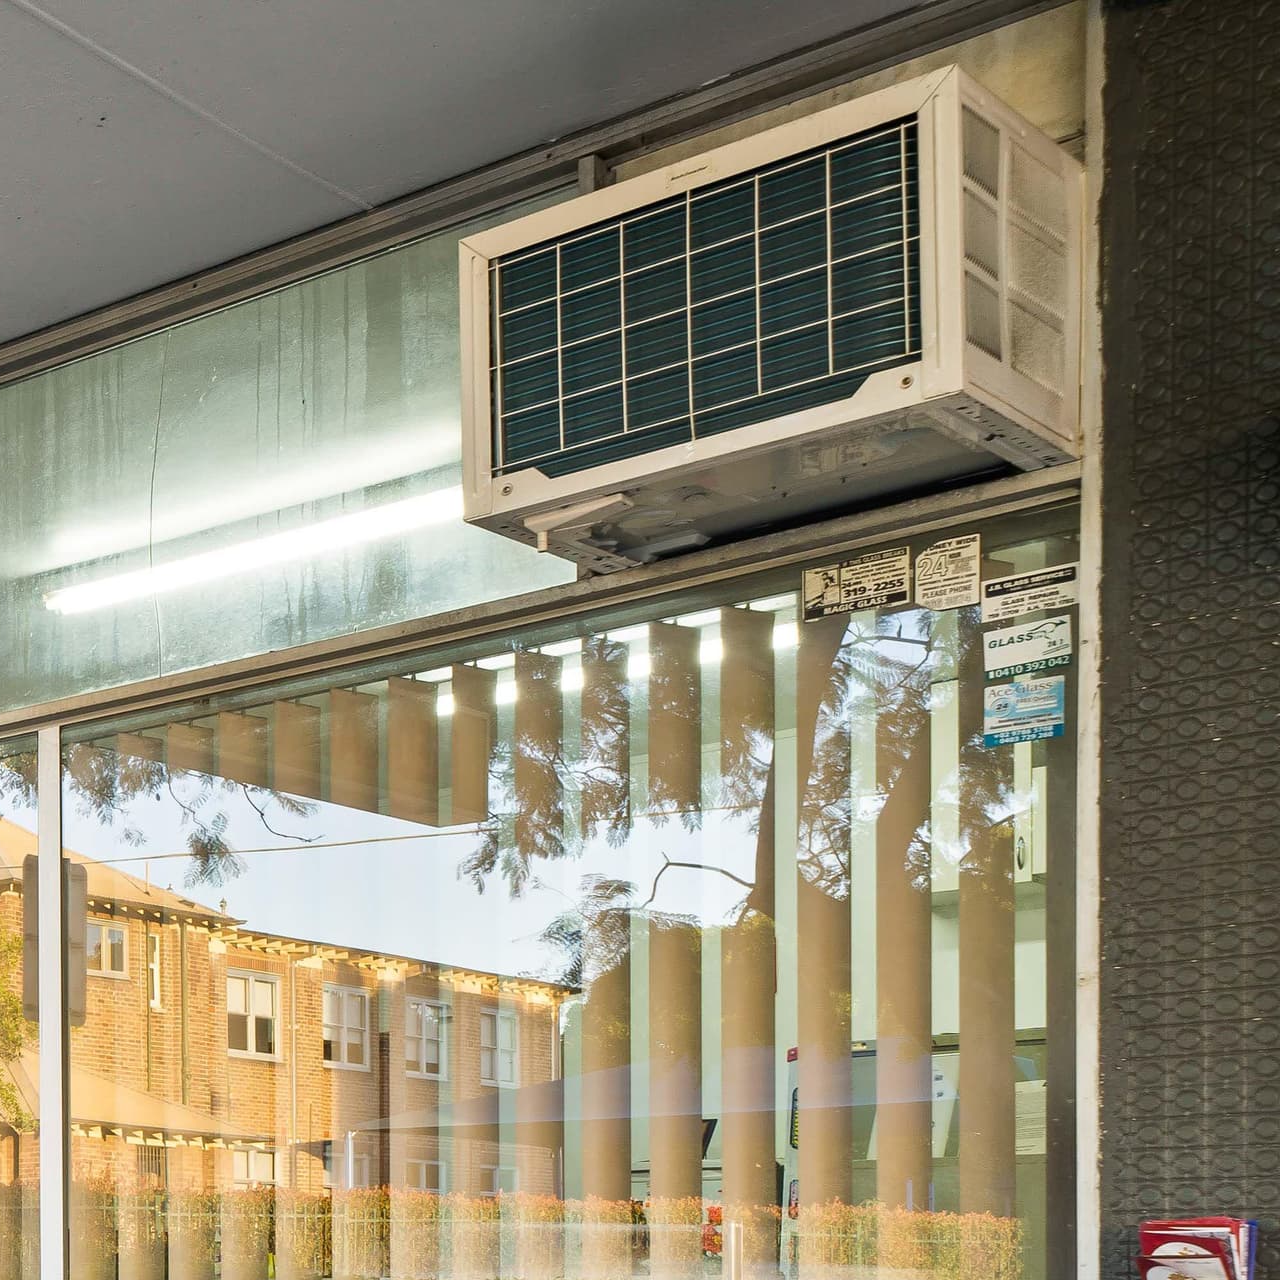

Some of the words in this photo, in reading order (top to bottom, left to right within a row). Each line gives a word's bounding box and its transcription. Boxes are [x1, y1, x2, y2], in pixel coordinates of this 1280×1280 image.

[917, 554, 949, 581] 24
[843, 577, 904, 599] 319-2255
[922, 588, 948, 599] PLEASE
[824, 602, 857, 615] MAGIC
[857, 595, 888, 608] GLASS
[988, 632, 1033, 649] GLASS
[995, 665, 1023, 679] 0410
[1025, 660, 1047, 673] 392
[1048, 655, 1070, 668] 042
[989, 689, 1013, 698] Ace
[1015, 681, 1053, 694] Glass
